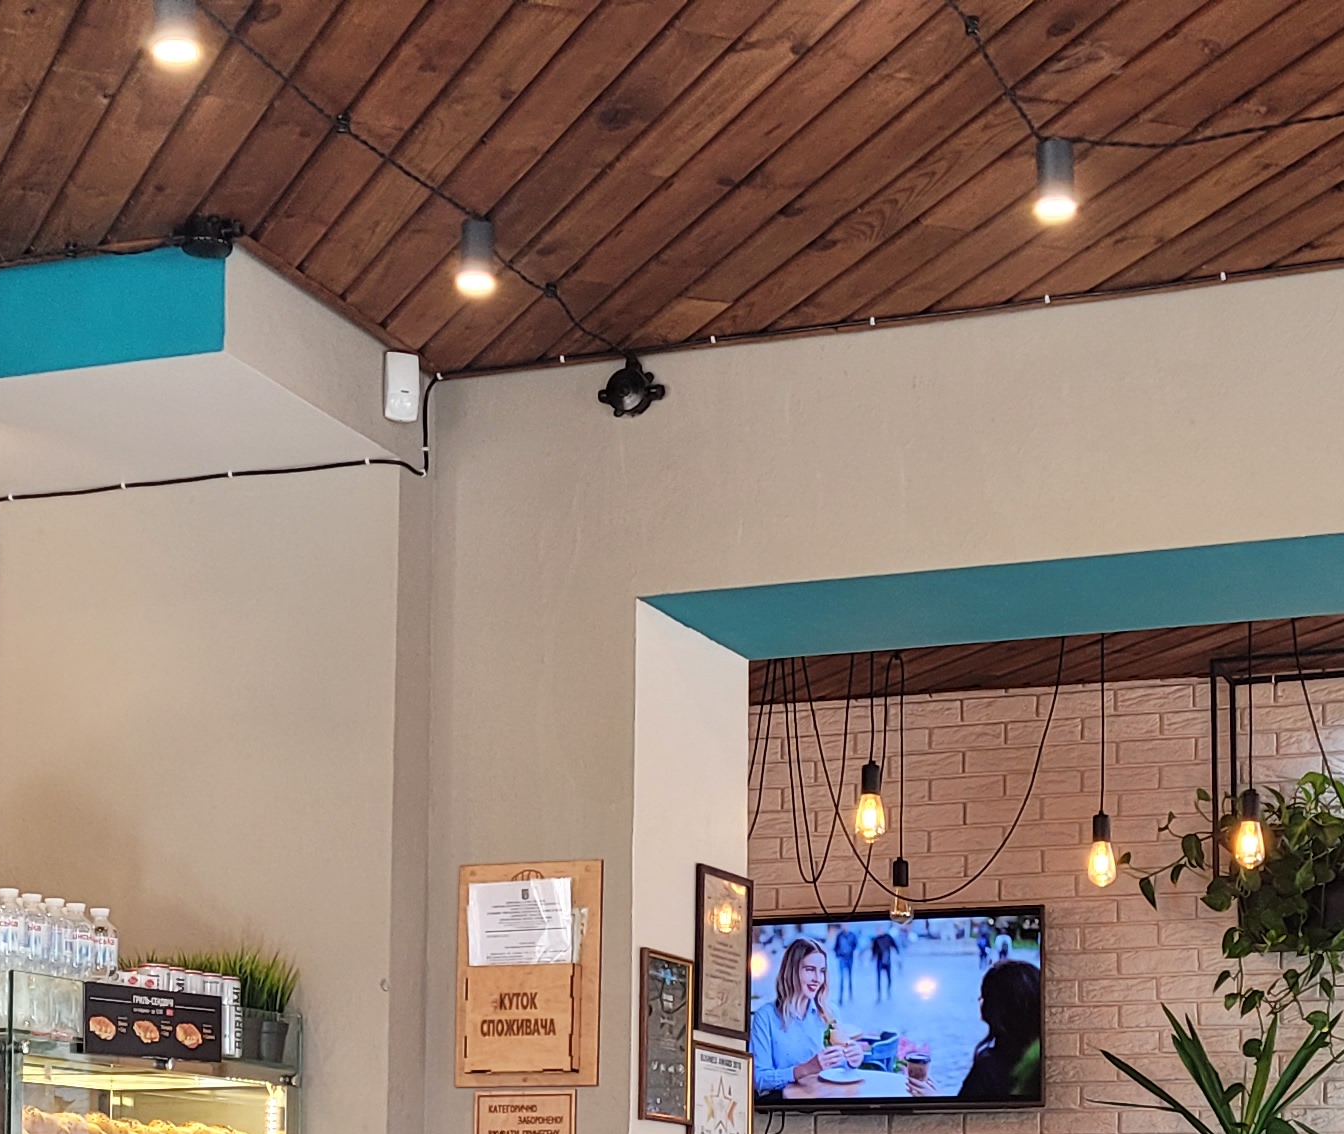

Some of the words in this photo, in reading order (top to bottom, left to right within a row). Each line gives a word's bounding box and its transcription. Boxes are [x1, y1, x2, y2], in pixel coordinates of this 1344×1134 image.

[499, 992, 538, 1010] КУТОК
[480, 1018, 557, 1037] СПОЖИВАЧА
[488, 1105, 537, 1113] КАТЕГОРИЧНО
